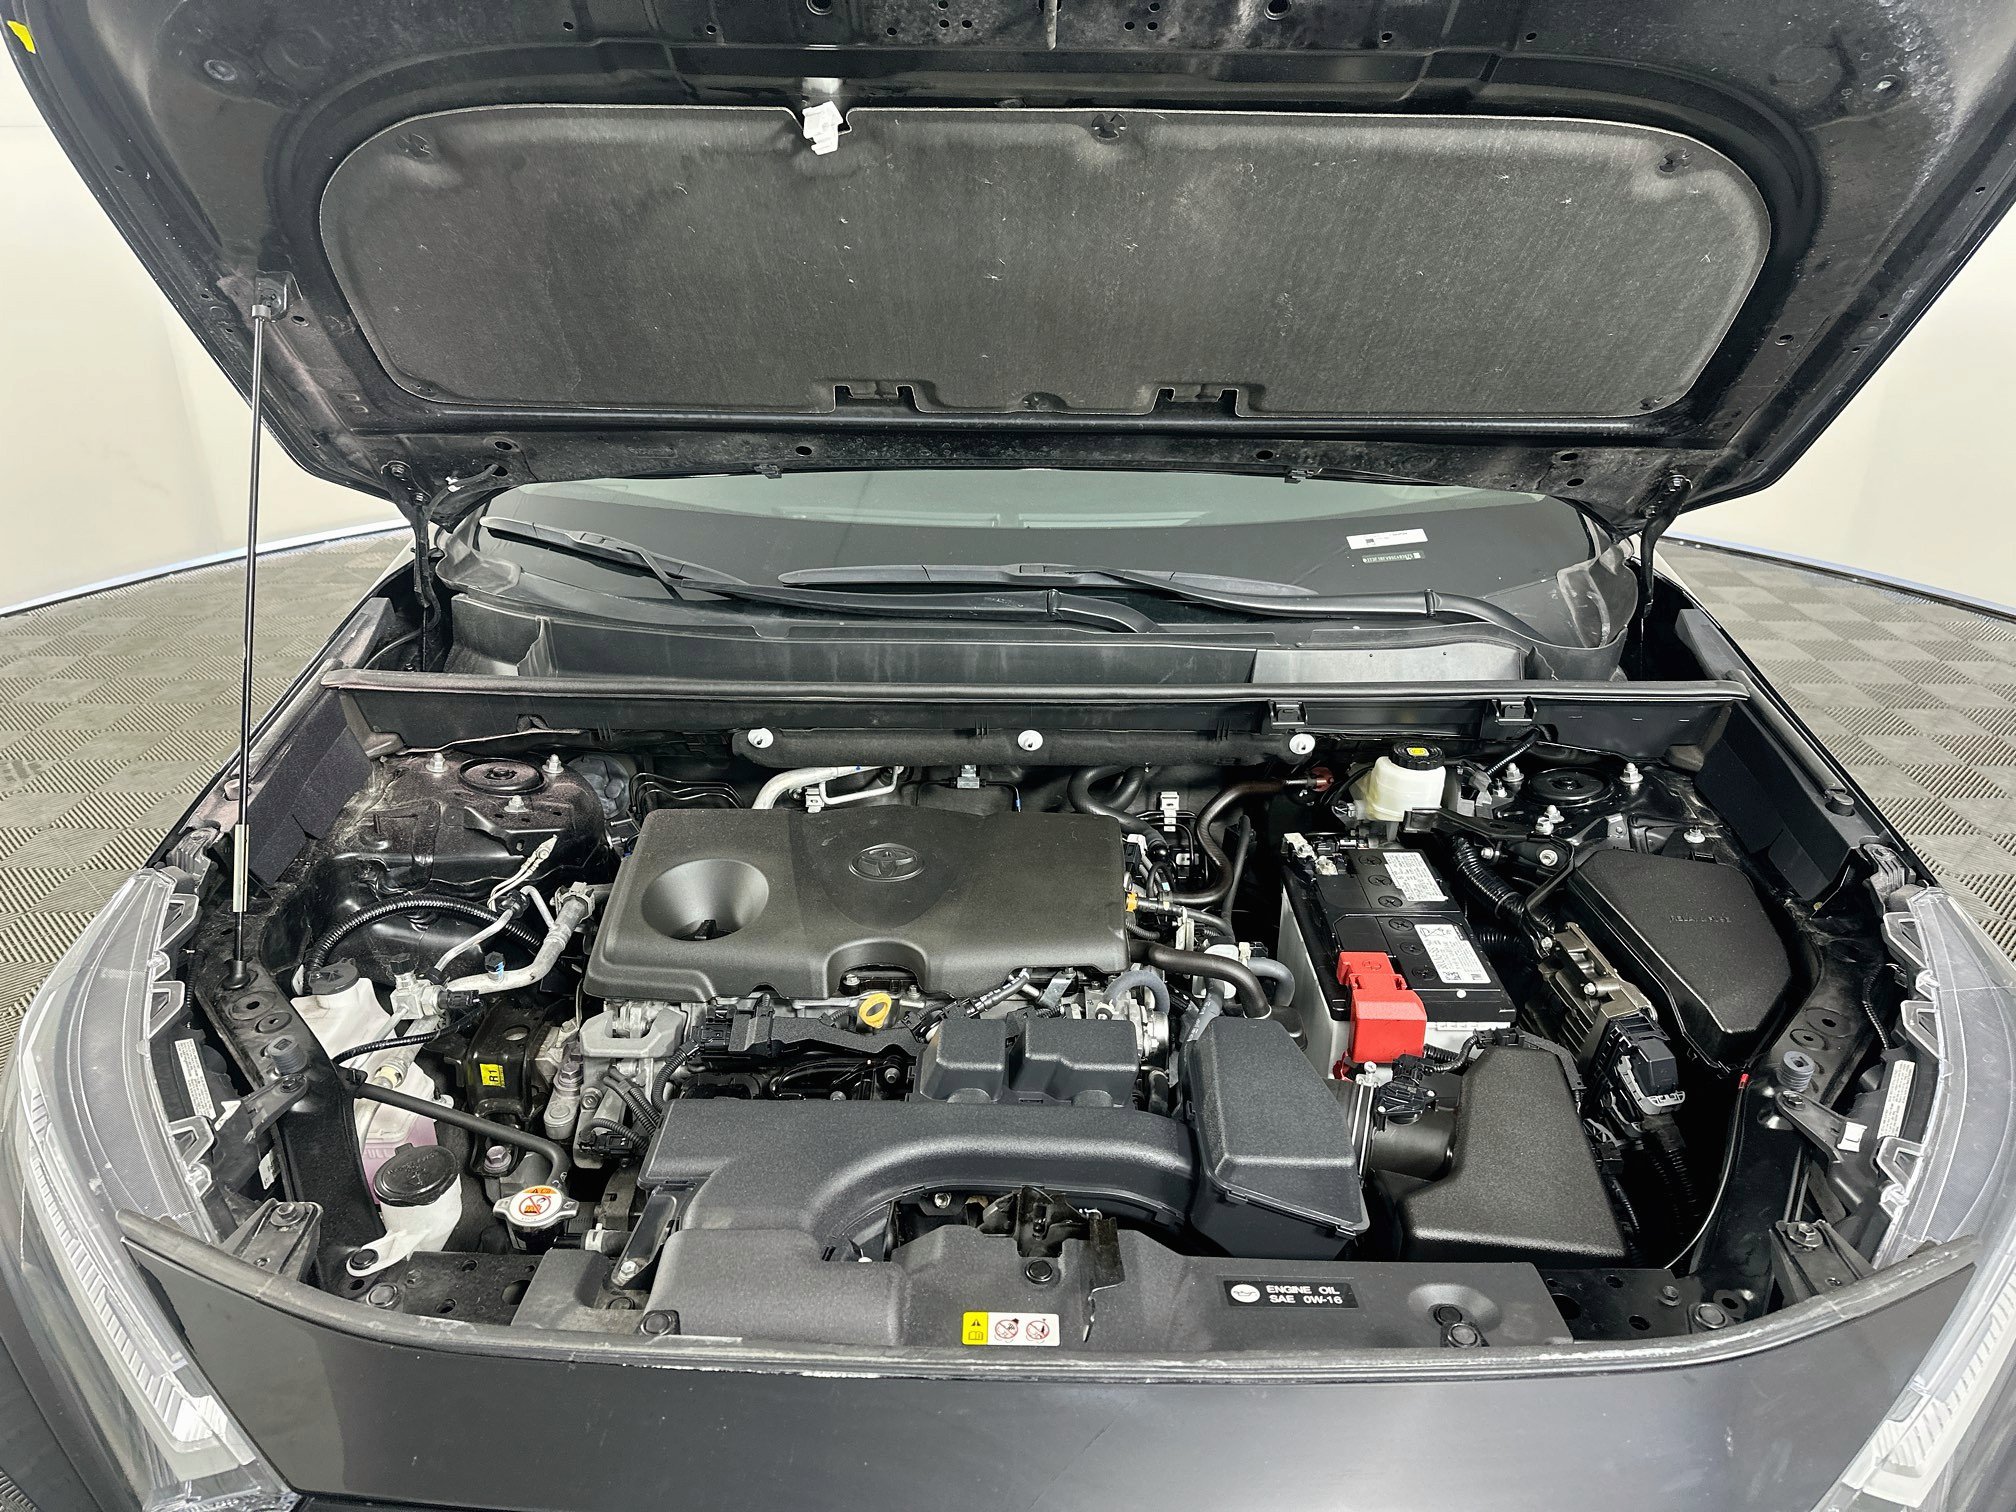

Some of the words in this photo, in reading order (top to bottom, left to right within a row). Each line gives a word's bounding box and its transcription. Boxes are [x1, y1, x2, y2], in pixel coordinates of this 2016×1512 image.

[488, 1070, 499, 1082] R1
[1266, 1285, 1312, 1294] ENGINE
[1318, 1286, 1340, 1295] OIL
[1269, 1295, 1296, 1303] SAE
[1303, 1295, 1343, 1305] 0W-16
